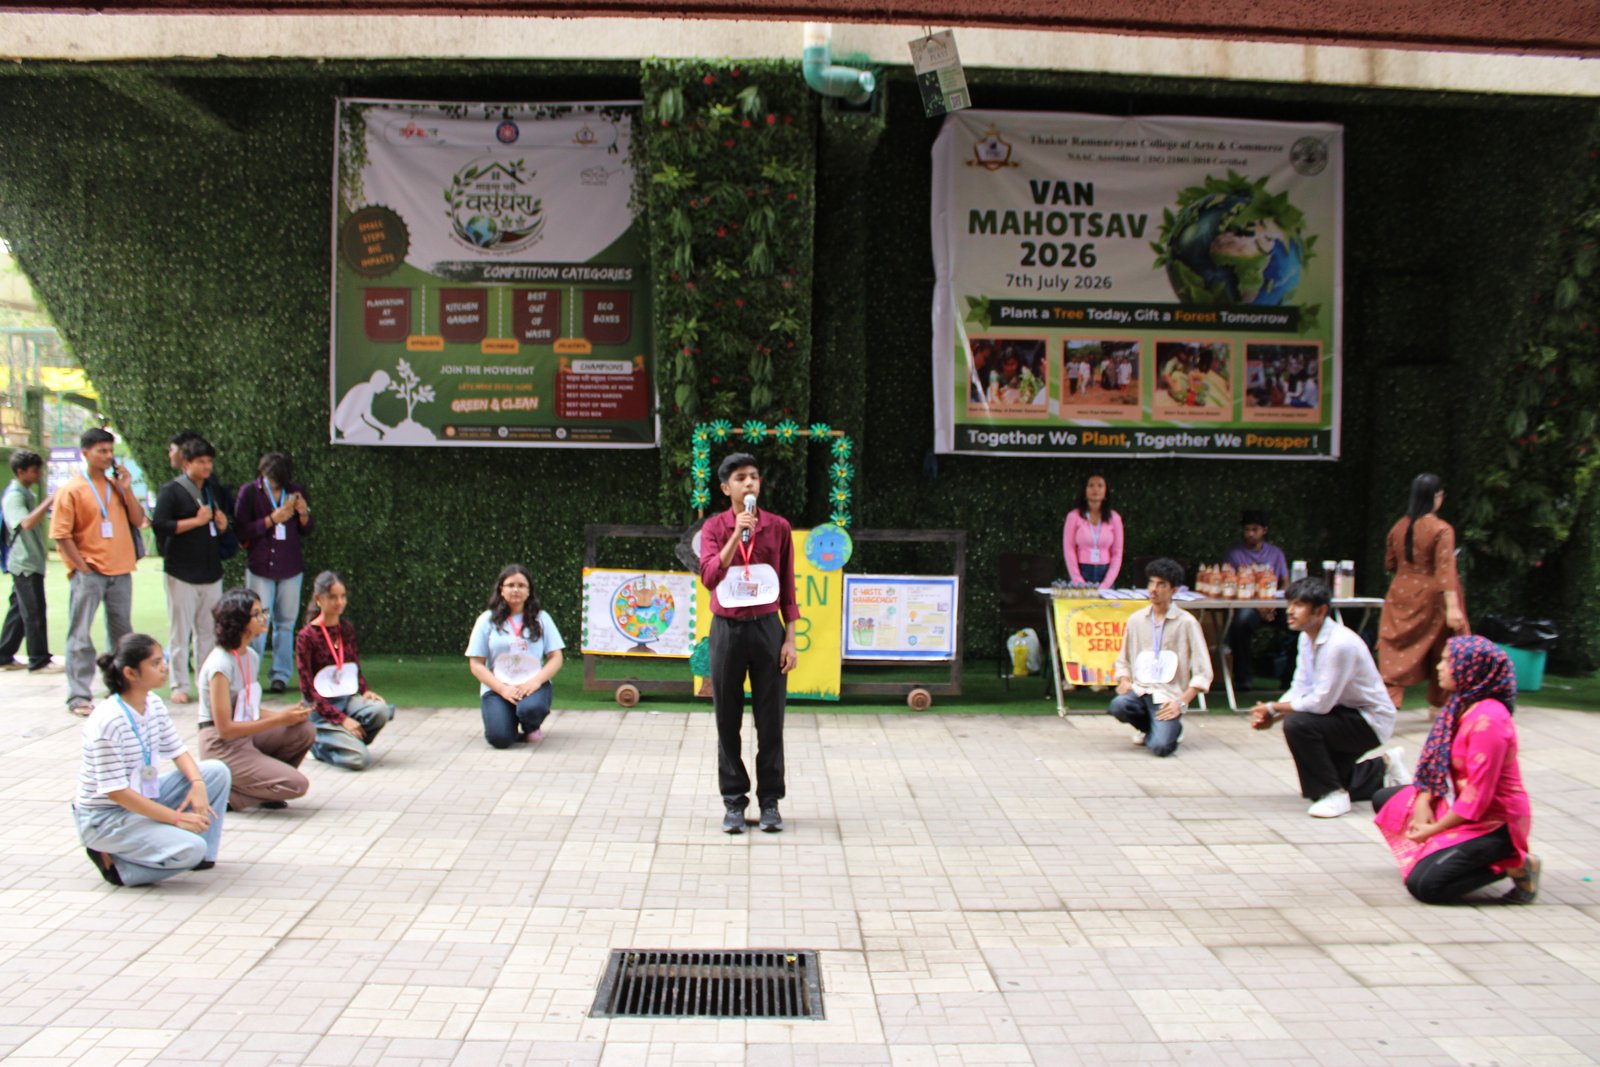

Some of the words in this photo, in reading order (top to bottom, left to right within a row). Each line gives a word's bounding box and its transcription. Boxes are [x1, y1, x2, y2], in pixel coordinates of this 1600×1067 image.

[1140, 139, 1177, 151] College
[1180, 140, 1192, 149] of
[1193, 141, 1215, 150] Arts
[1218, 141, 1227, 150] &
[1230, 142, 1284, 152] Commerce
[1029, 180, 1094, 206] VAN
[967, 209, 1148, 239] MAHOTSAV
[360, 253, 395, 267] IMPACTS
[1020, 241, 1097, 268] 2026
[483, 266, 558, 279] COMPETITION
[562, 267, 632, 281] CATEGORIES
[1005, 273, 1033, 289] 7th
[1037, 273, 1070, 292] July
[1074, 274, 1112, 290] 2026
[527, 291, 547, 301] BEST
[367, 298, 405, 308] PLANTATION
[445, 302, 479, 312] KITCHEN
[528, 304, 545, 313] OUT
[597, 302, 614, 311] ECO
[446, 314, 480, 325] GARDEN
[593, 314, 621, 324] BOXES
[1001, 307, 1038, 320] Plant
[1041, 311, 1050, 320] a
[1053, 307, 1084, 321] Tree
[1087, 308, 1132, 323] Today,
[1134, 309, 1159, 322] Gift
[1162, 313, 1171, 322] a
[1174, 310, 1217, 323] Forest
[1220, 311, 1289, 324] Tomorrow
[378, 318, 396, 326] HOME
[531, 317, 543, 326] OF
[525, 329, 551, 339] WASTE
[440, 365, 463, 375] JOIN
[464, 365, 481, 375] THE
[483, 366, 535, 376] MOVEMENT
[580, 363, 624, 371] CHAMPIONS
[451, 398, 489, 412] GREEN
[490, 397, 501, 411] &
[501, 396, 539, 410] CLEAN
[967, 429, 1045, 449] Together
[1048, 431, 1078, 446] We
[1081, 431, 1131, 448] Plant,
[1135, 433, 1211, 451] Together
[1214, 434, 1242, 448] We
[853, 596, 897, 604] MANAGEMENT
